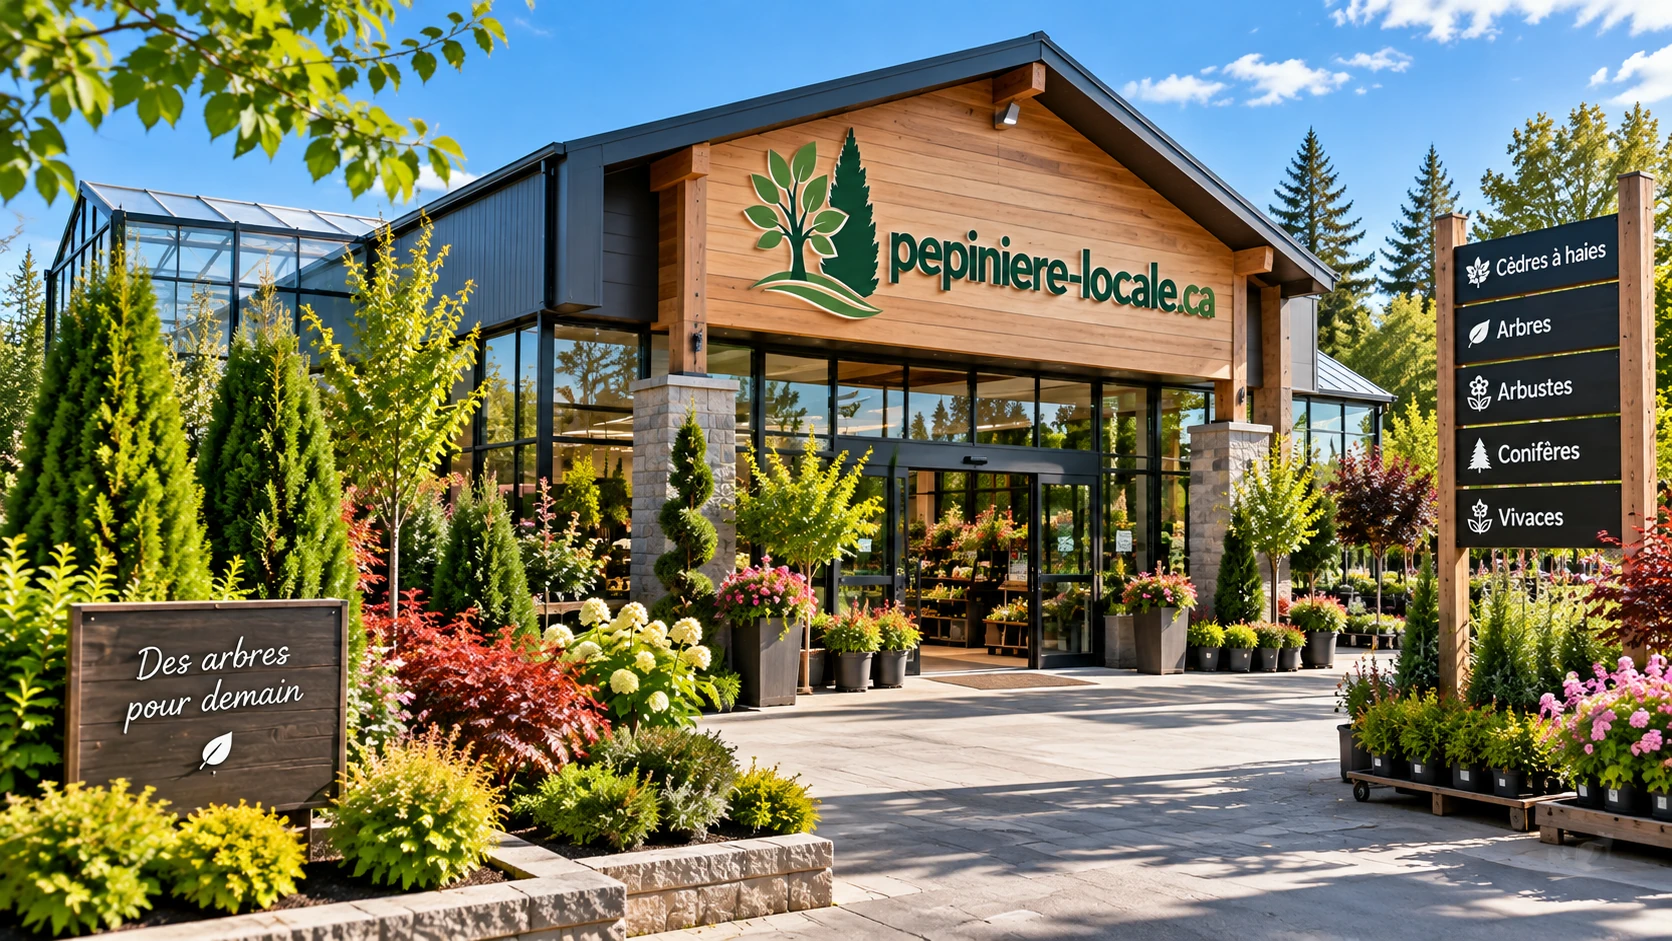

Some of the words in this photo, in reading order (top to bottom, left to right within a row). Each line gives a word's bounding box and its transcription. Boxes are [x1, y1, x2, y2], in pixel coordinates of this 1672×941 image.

[889, 229, 1215, 318] pepiniere-locale.ca
[1496, 253, 1549, 277] Cèdres
[1551, 247, 1562, 267] à
[1565, 241, 1607, 265] haies
[1496, 317, 1552, 339] Arbres
[1497, 378, 1573, 402] Arbustes
[1498, 507, 1564, 527] Vivaces
[136, 646, 193, 681] Des
[201, 635, 291, 671] arbres
[123, 695, 192, 735] pour
[201, 678, 305, 712] demain
